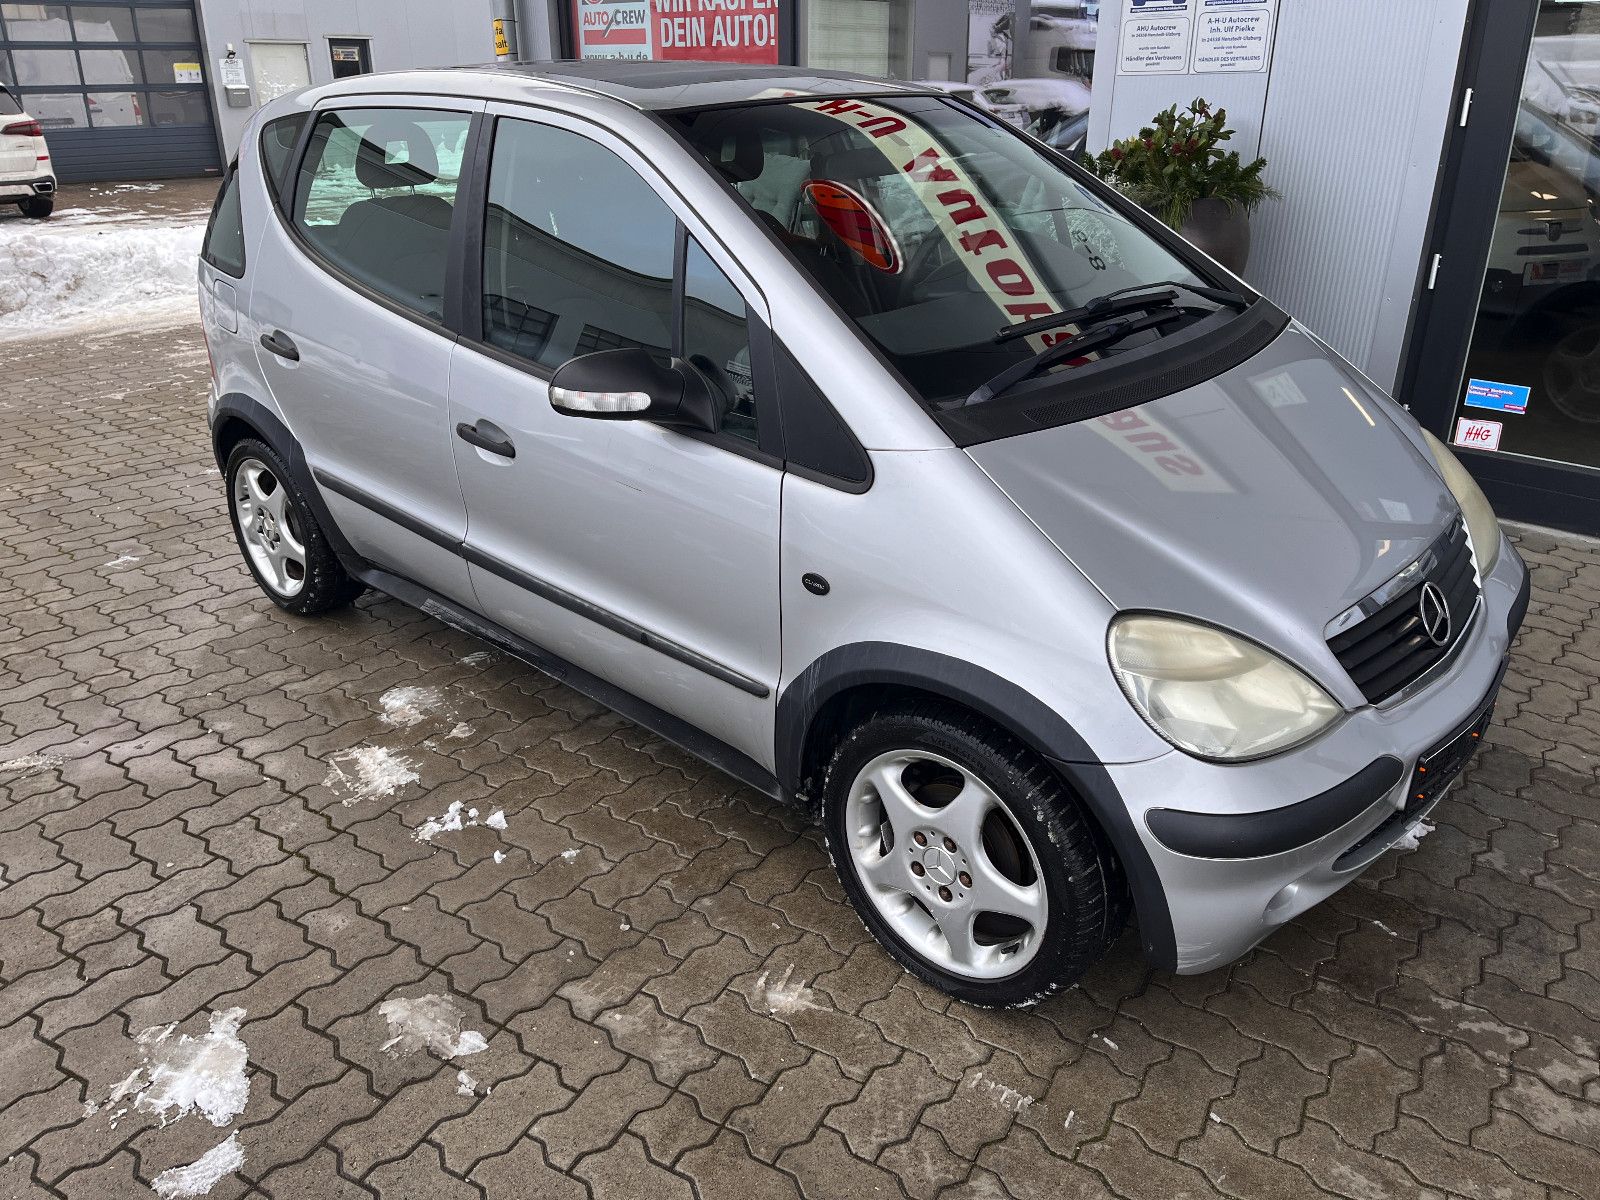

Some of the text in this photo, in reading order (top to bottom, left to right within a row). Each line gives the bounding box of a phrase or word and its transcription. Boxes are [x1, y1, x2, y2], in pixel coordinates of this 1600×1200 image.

[660, 14, 776, 48] DEIN AUTO!
[1464, 425, 1492, 441] HHG
